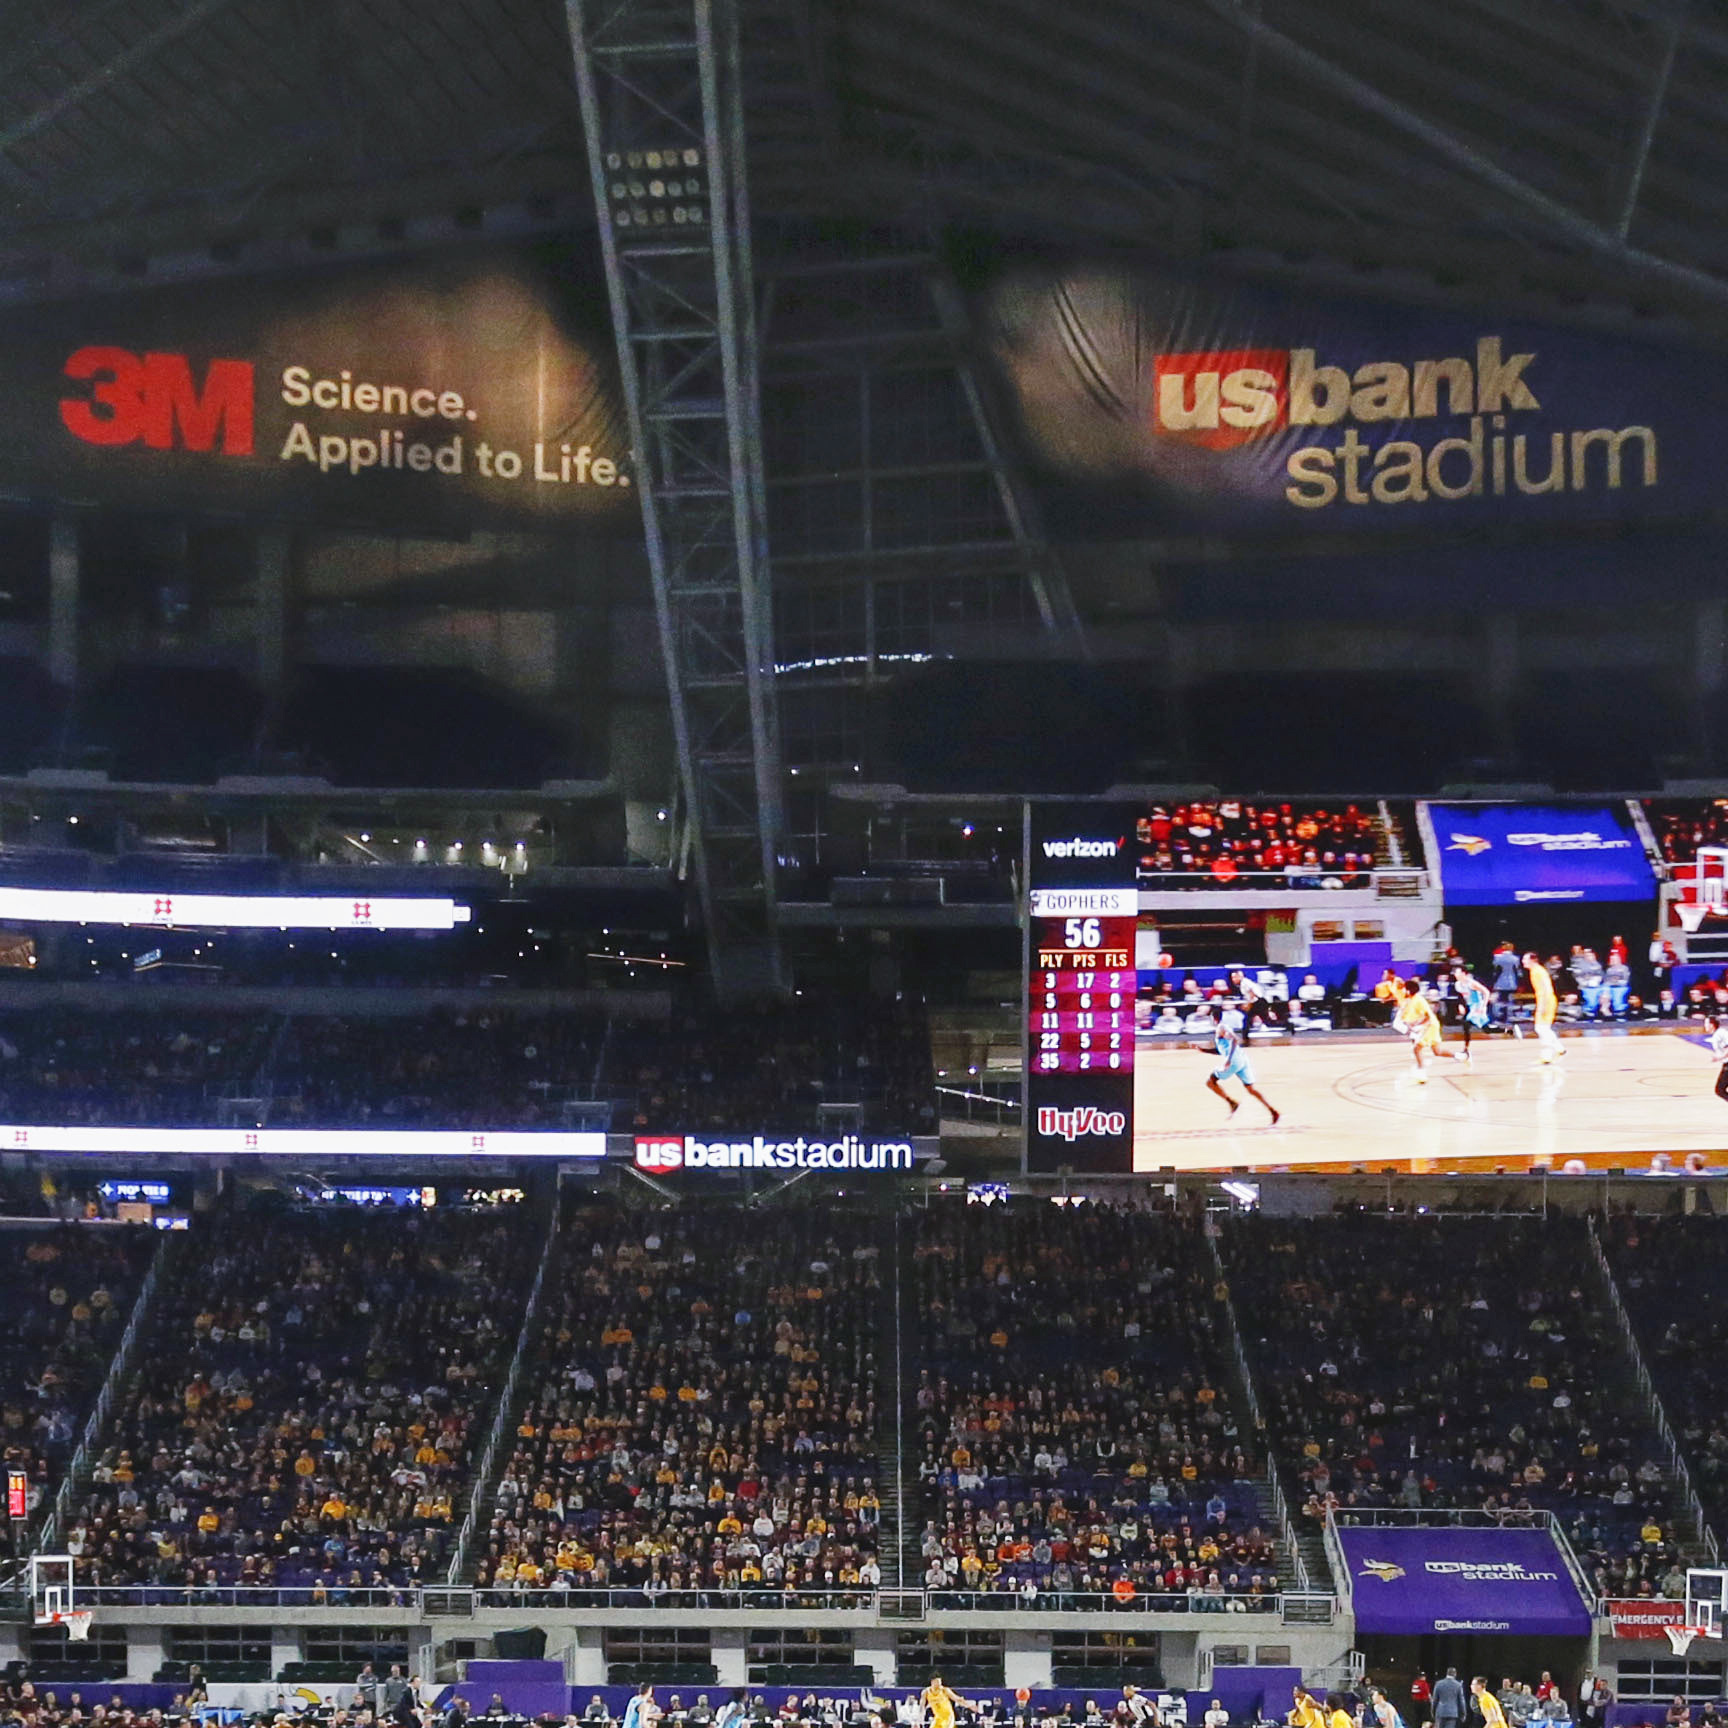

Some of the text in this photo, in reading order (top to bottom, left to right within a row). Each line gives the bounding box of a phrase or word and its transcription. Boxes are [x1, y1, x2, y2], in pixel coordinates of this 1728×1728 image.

[59, 345, 254, 456] 3M
[281, 366, 477, 421] Science.
[281, 422, 629, 488] Applied to Life.
[1285, 414, 1658, 509] stadium
[1042, 837, 1116, 857] verizon
[1046, 893, 1120, 910] GOPHERS
[1064, 918, 1101, 948] 56
[1040, 953, 1128, 968] PLY PTS FLS
[1045, 972, 1121, 989] 3 17 2
[1045, 992, 1121, 1009] 5 6 0
[1041, 1012, 1119, 1029] 11 11 1
[1040, 1032, 1121, 1049] 22 5 2
[1040, 1052, 1121, 1069] 35 2 0
[1462, 1569, 1558, 1581] stadium
[1611, 1614, 1672, 1625] EMERGENCY
